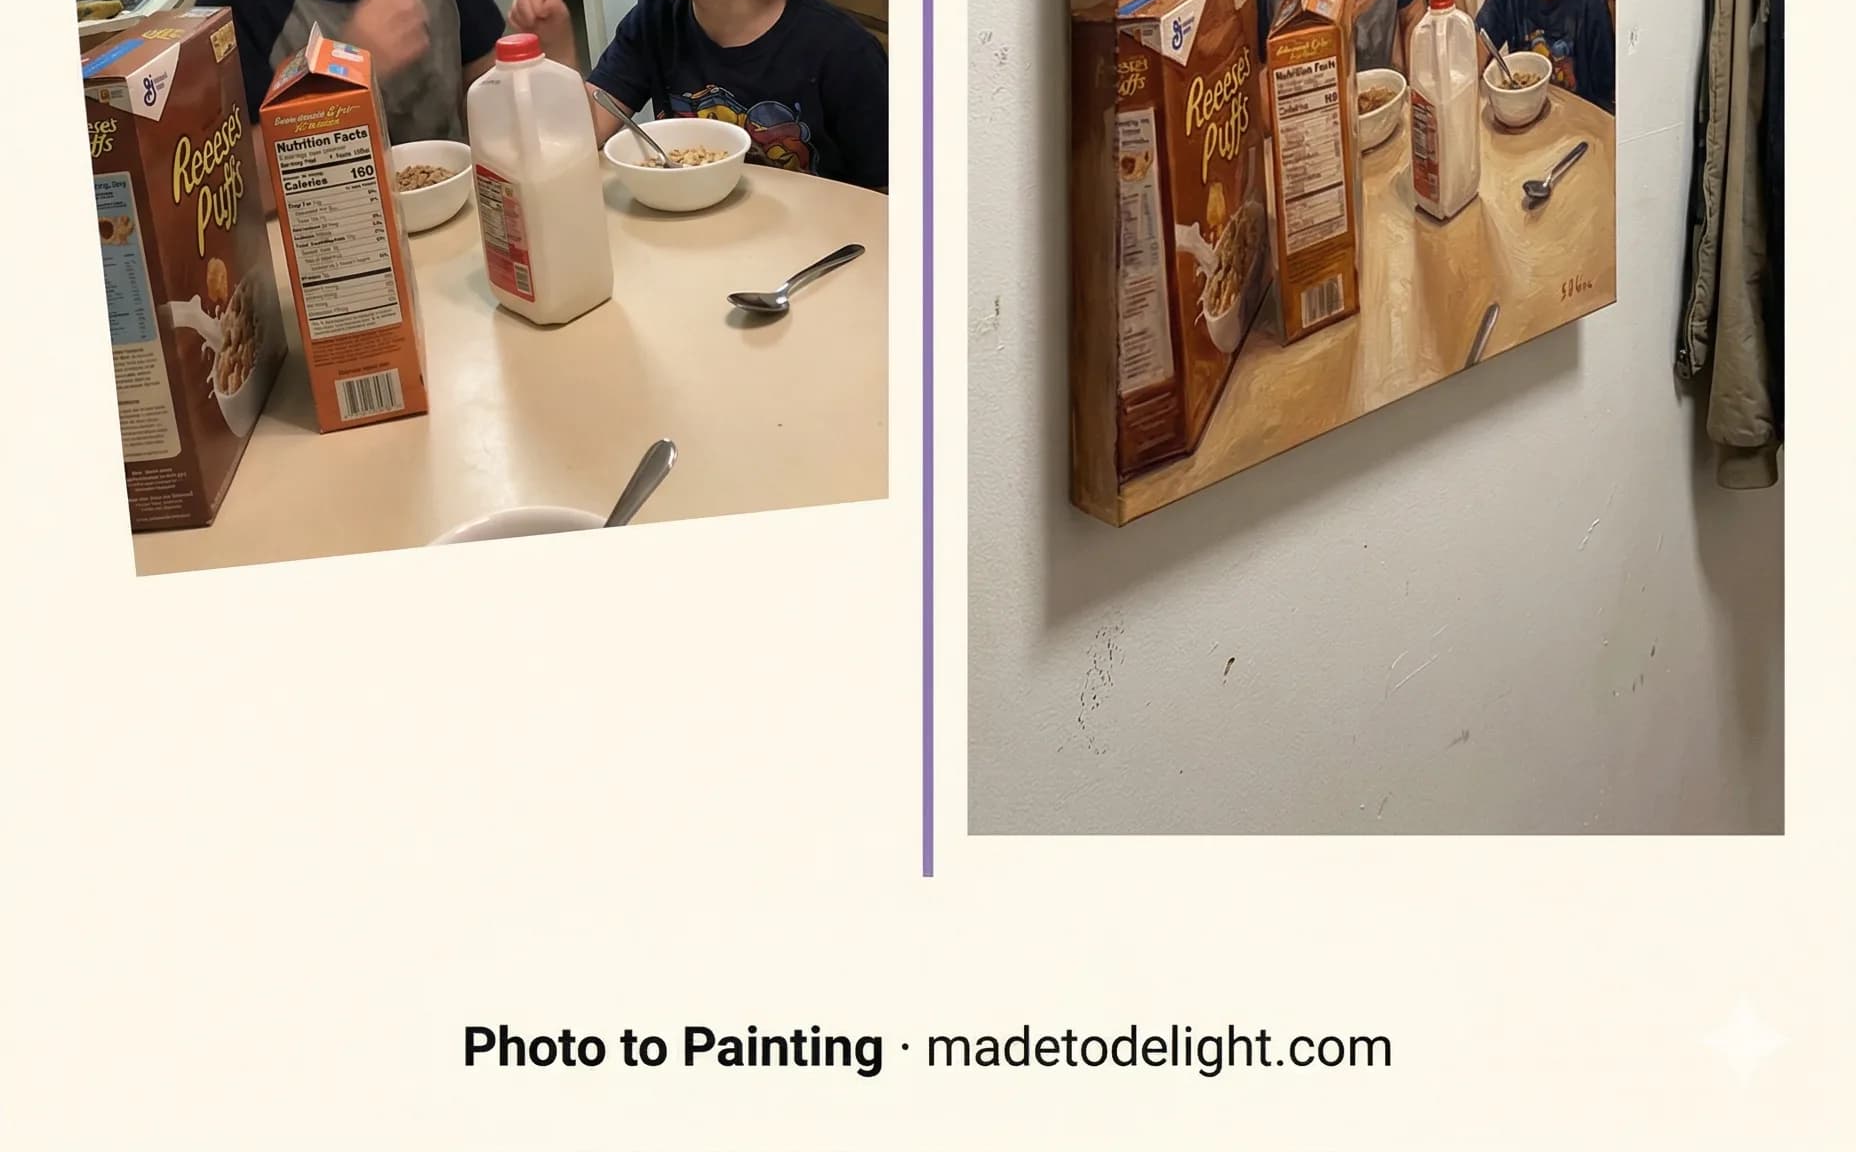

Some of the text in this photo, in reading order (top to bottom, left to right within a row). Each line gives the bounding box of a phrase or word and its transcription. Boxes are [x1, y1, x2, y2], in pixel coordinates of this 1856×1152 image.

[275, 128, 369, 154] Nutrition Facts
[1202, 91, 1250, 185] Puffs
[197, 154, 245, 258] Puffs
[284, 176, 329, 192] Calories
[350, 164, 375, 180] 160
